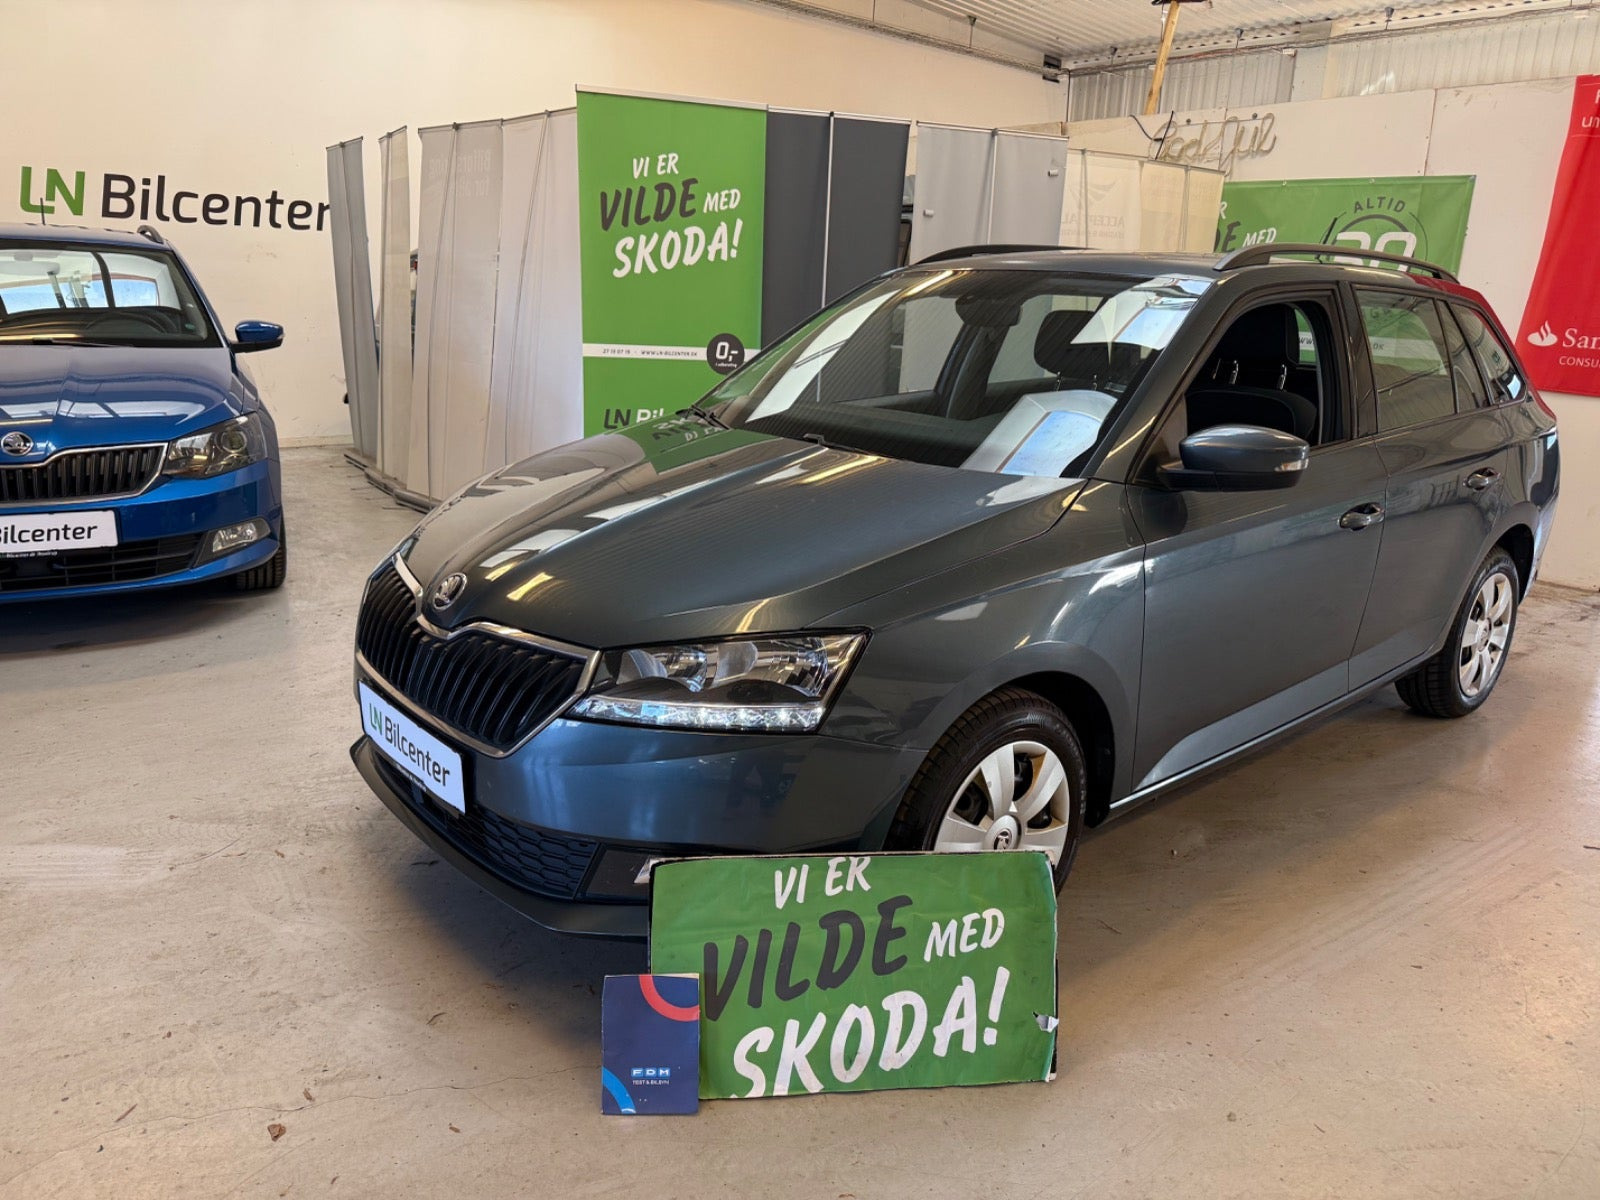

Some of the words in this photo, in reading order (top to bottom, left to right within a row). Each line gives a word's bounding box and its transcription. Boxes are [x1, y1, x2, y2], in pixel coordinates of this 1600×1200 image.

[632, 156, 650, 179] VI
[656, 152, 679, 175] ER
[19, 166, 85, 216] LN
[101, 173, 330, 231] Bilcenter
[600, 177, 698, 232] VILDE
[703, 188, 741, 213] MED
[1220, 201, 1228, 220] R
[1354, 196, 1406, 213] ALTID
[612, 217, 743, 278] SKODA!
[1214, 220, 1241, 252] E
[1242, 227, 1277, 248] MED
[1559, 355, 1600, 368] CONSU
[604, 408, 632, 430] LN
[0, 524, 98, 544] ilcenter
[369, 703, 383, 736] LN
[384, 716, 451, 787] Bilcenter
[774, 865, 808, 909] VI
[825, 856, 871, 896] ER
[703, 895, 913, 1021] VILDE
[924, 908, 1005, 962] MED
[730, 966, 1010, 1098] SKODA!
